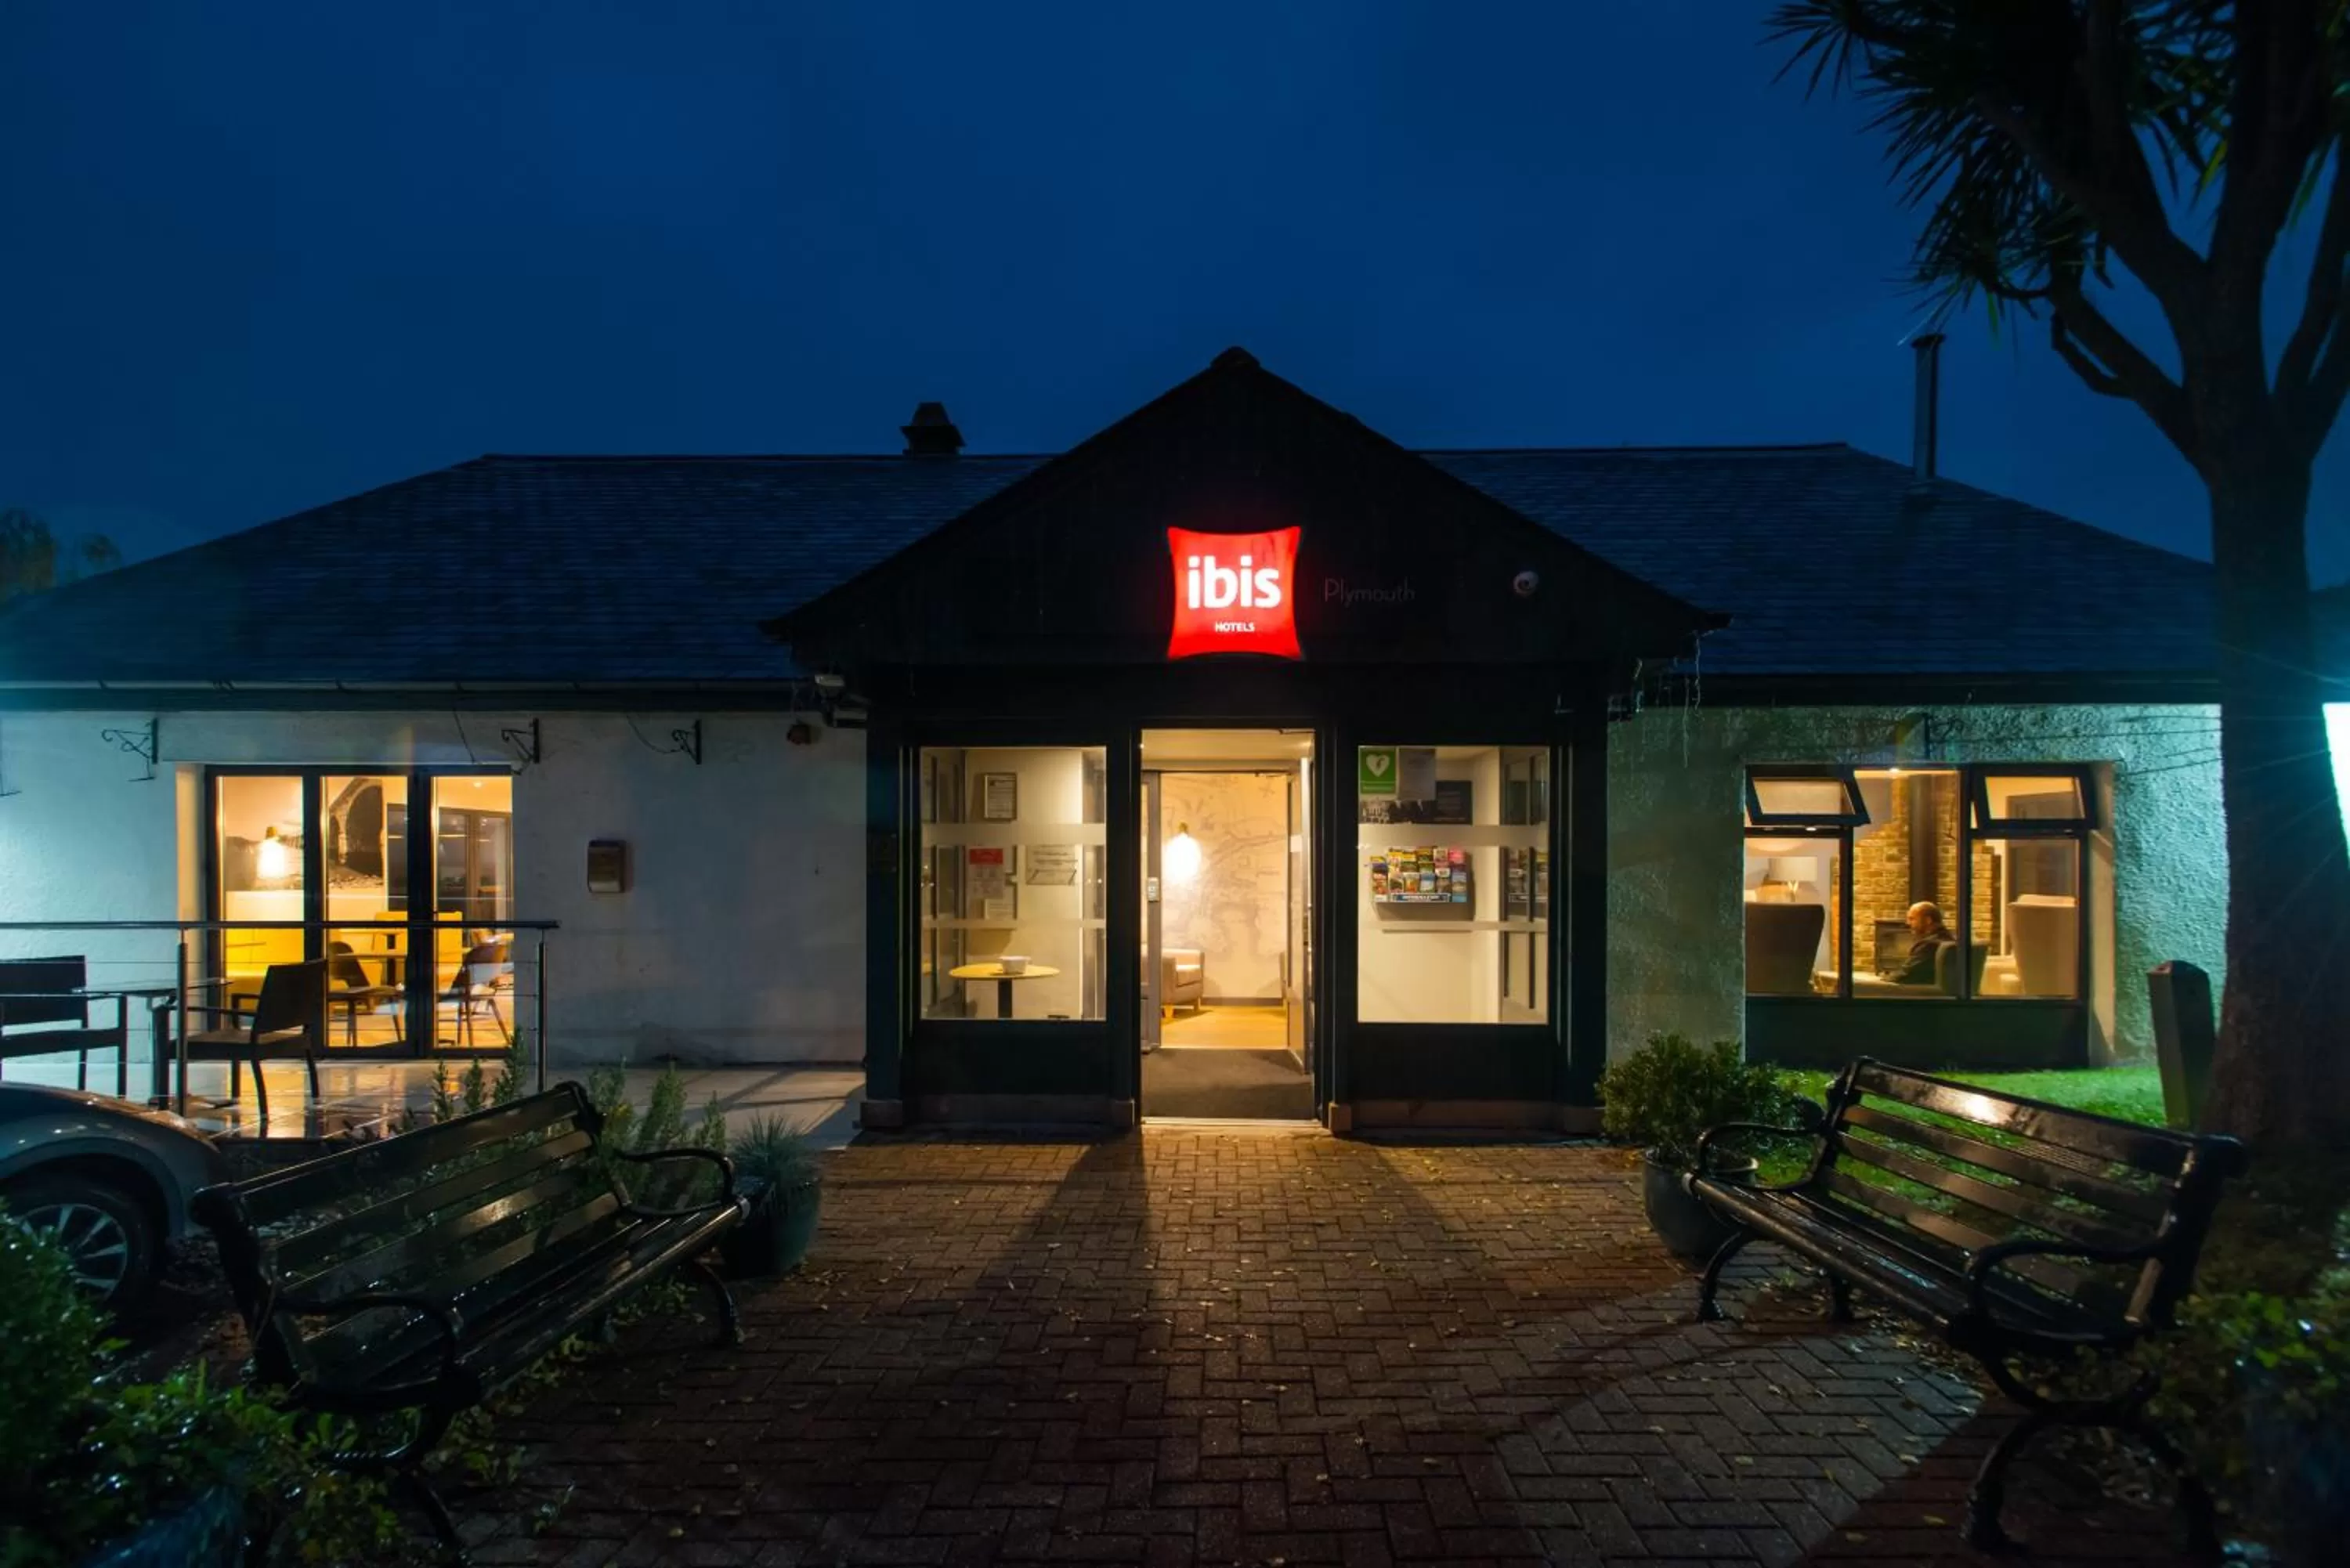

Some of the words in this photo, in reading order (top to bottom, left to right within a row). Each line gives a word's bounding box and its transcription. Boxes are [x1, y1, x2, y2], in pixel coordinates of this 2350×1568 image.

[1188, 555, 1282, 609] ibis
[1324, 576, 1416, 609] Plymouth
[1215, 621, 1255, 633] HOTELS
